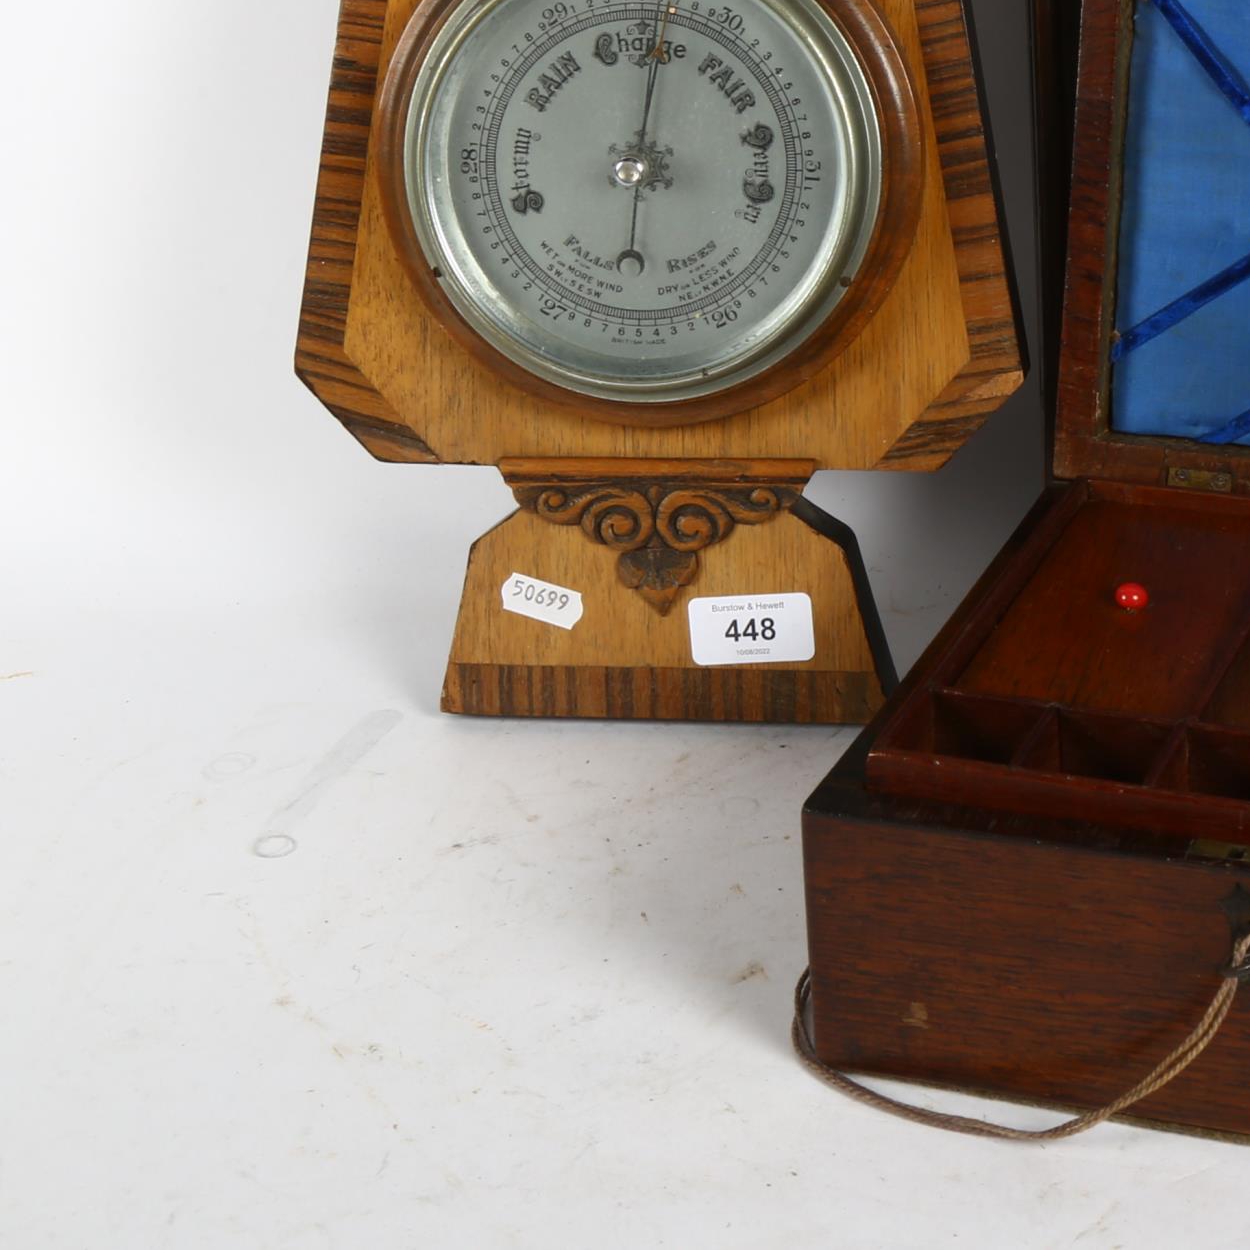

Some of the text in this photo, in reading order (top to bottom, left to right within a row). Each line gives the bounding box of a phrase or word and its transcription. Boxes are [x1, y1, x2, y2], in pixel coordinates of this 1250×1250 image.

[586, 0, 594, 7] 2
[691, 1, 699, 10] 8
[542, 2, 568, 26] 29
[708, 8, 716, 17] 9
[717, 6, 743, 30] 30
[538, 22, 546, 30] 9
[524, 33, 533, 41] 8
[751, 39, 759, 47] 2
[512, 45, 520, 53] 7
[763, 52, 772, 60] 3
[501, 59, 509, 67] 6
[491, 74, 499, 82] 5
[524, 50, 582, 112] RAIN
[698, 52, 756, 114] FAIR
[476, 106, 486, 114] 3
[461, 149, 478, 174] 28
[511, 127, 544, 215] Stormy
[805, 160, 821, 181] 31
[796, 219, 805, 227] 3
[781, 250, 789, 258] 5
[541, 240, 559, 259] WET
[569, 265, 594, 284] MORE
[597, 279, 623, 293] WIND
[772, 264, 779, 272] 6
[512, 270, 520, 278] 3
[658, 284, 679, 296] DRY
[692, 265, 718, 286] LESS
[719, 246, 739, 268] WIND
[760, 277, 768, 285] 7
[523, 282, 532, 290] 2
[748, 289, 756, 297] 8
[733, 300, 741, 308] 9
[540, 299, 567, 320] 27
[568, 311, 575, 320] 9
[711, 305, 738, 328] 26
[584, 319, 591, 327] 8
[687, 322, 695, 330] 2
[602, 323, 608, 332] 7
[618, 327, 625, 335] 6
[670, 326, 677, 335] 3
[635, 328, 642, 337] 5
[653, 328, 660, 336] 4
[512, 580, 569, 610] 50699
[711, 601, 784, 612] Burstow & Hewett
[725, 617, 776, 642] 448
